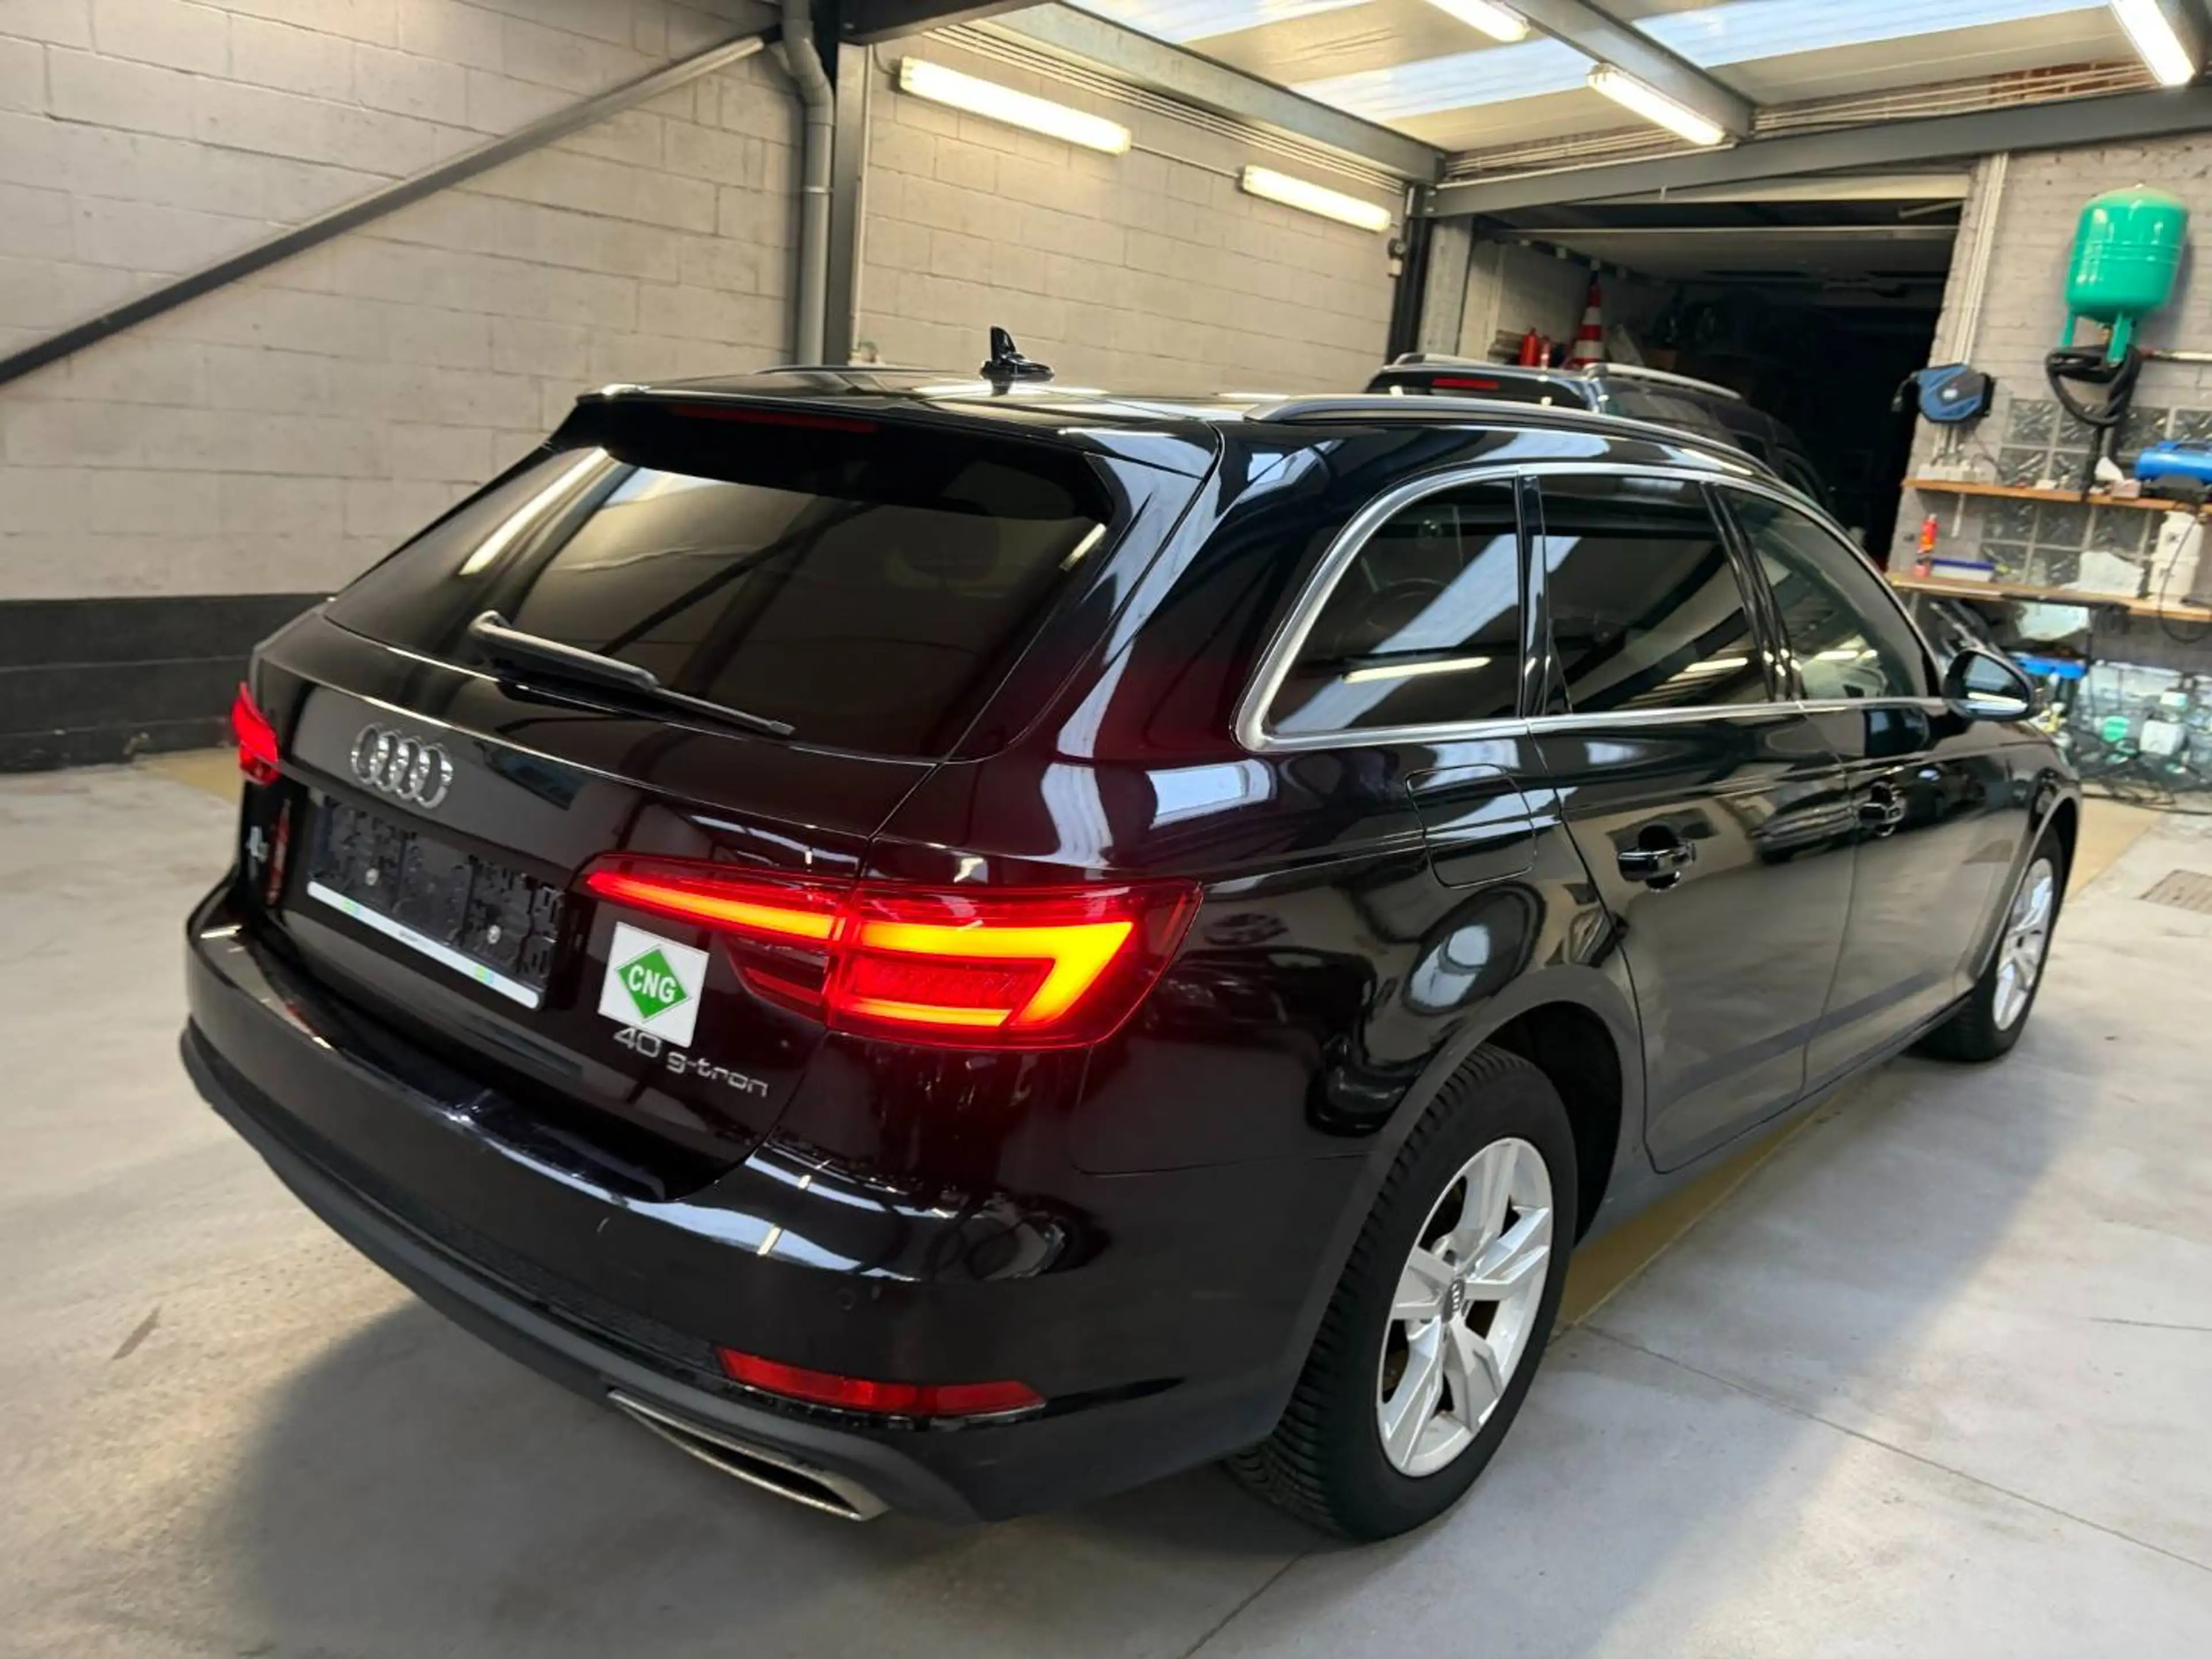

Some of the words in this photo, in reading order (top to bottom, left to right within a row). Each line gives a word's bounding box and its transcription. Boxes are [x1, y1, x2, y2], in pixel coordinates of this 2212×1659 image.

[628, 965, 676, 1003] CNG
[613, 1027, 661, 1058] 40
[666, 1051, 768, 1097] g-tron
